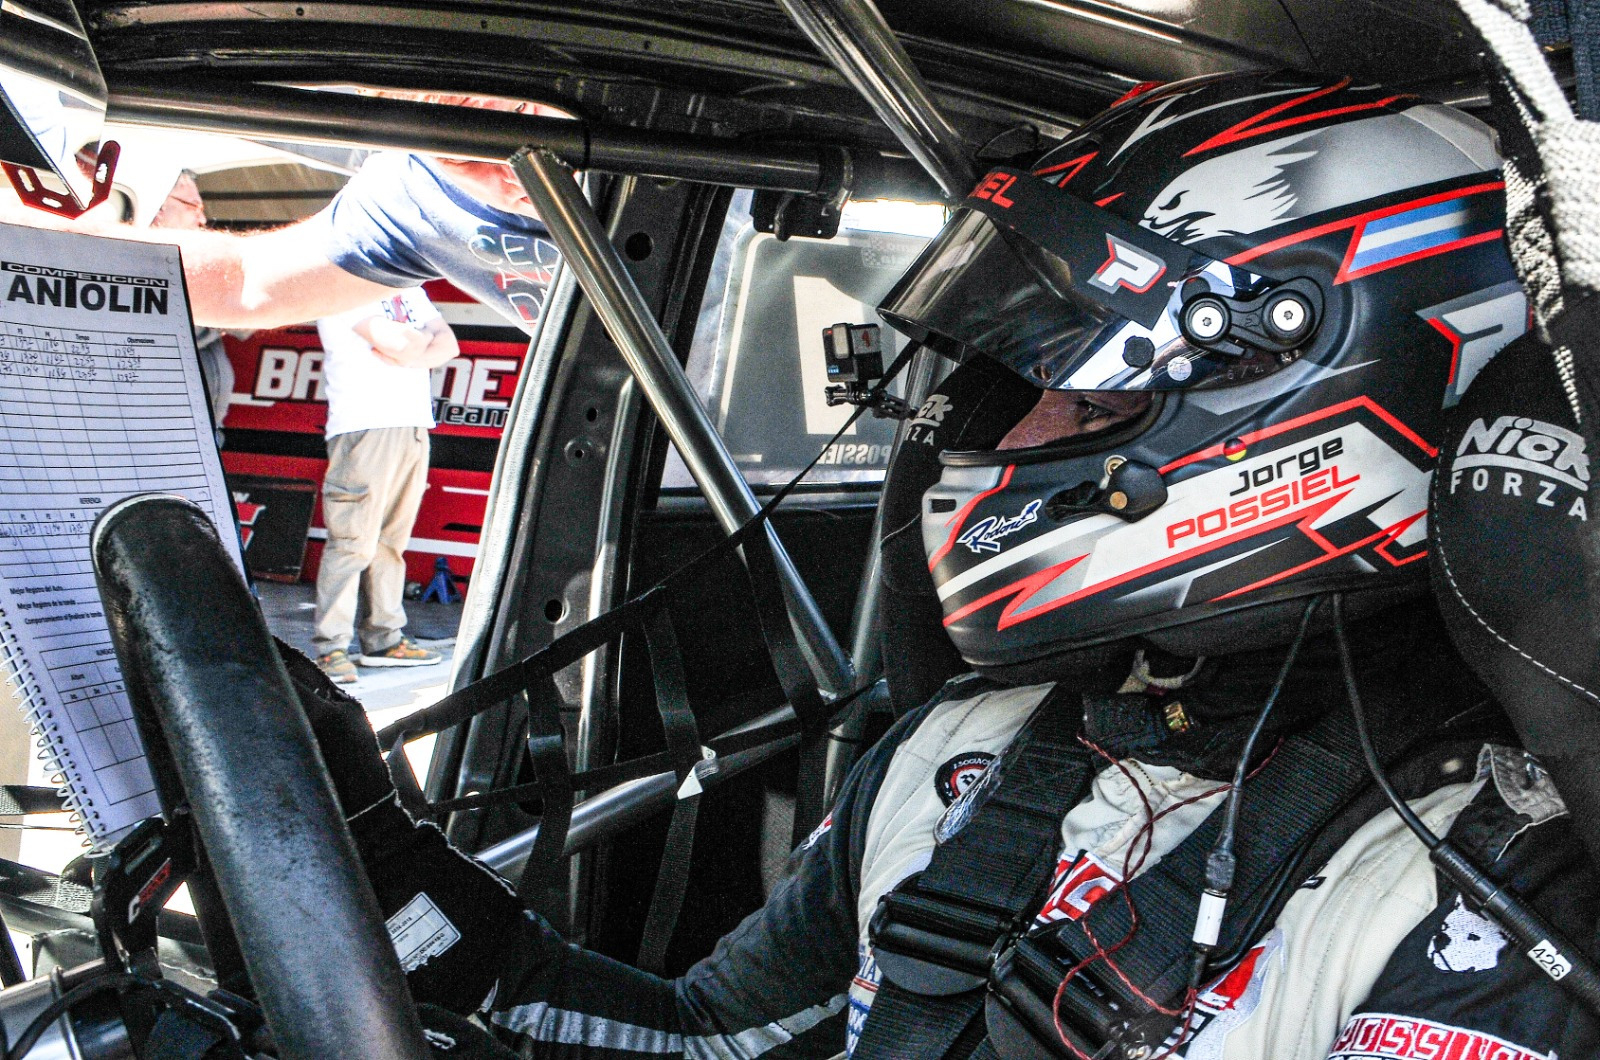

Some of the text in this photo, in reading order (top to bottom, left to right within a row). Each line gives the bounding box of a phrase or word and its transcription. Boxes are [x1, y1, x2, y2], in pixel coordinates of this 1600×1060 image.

[7, 263, 166, 287] COMPETICION
[7, 273, 168, 315] ANTOLIN
[1230, 436, 1344, 496] Jorge
[1166, 465, 1361, 548] POSSIEL
[1450, 468, 1588, 521] FORZA
[1531, 947, 1565, 978] 426
